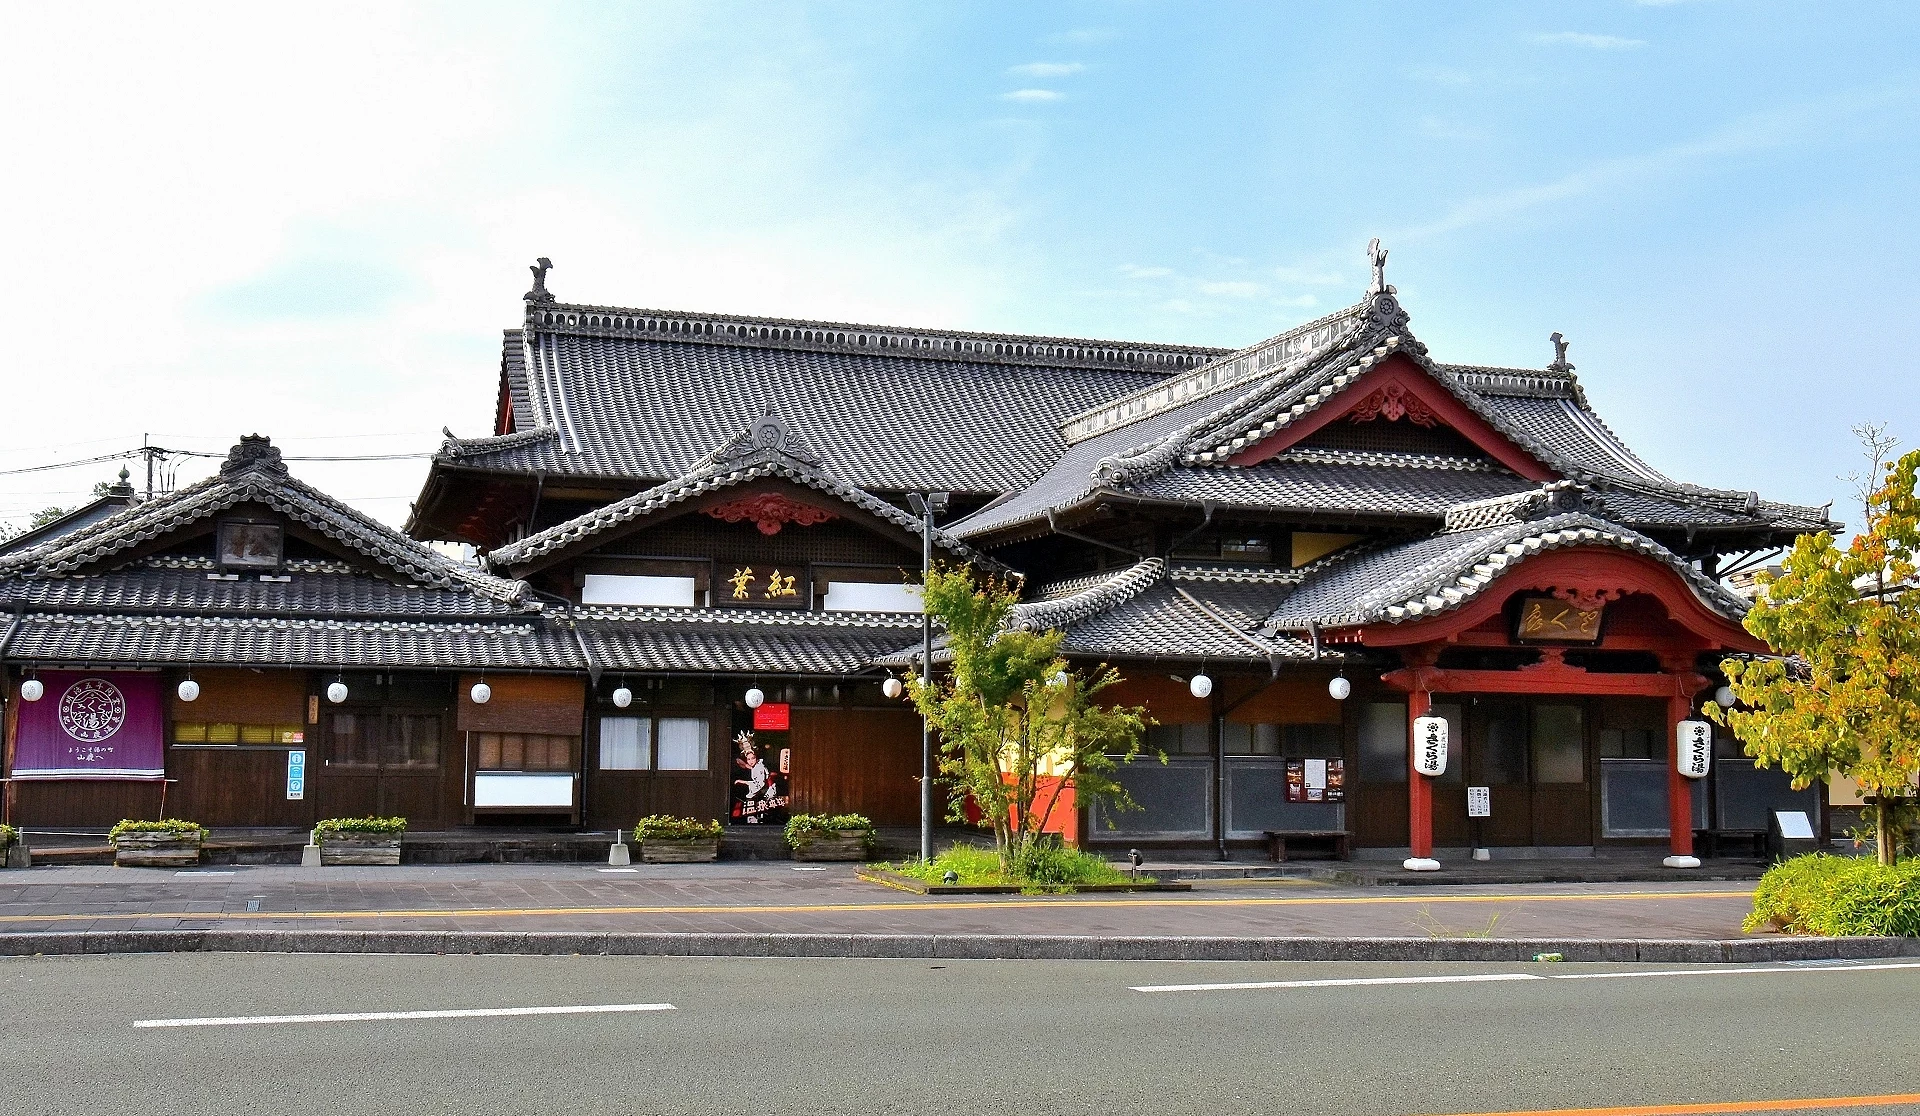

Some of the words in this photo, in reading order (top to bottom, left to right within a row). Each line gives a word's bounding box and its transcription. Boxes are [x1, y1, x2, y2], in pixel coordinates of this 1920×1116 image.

[77, 752, 104, 761] 山鹿へ
[1425, 733, 1439, 771] さくら湯
[1692, 736, 1705, 773] さくら湯
